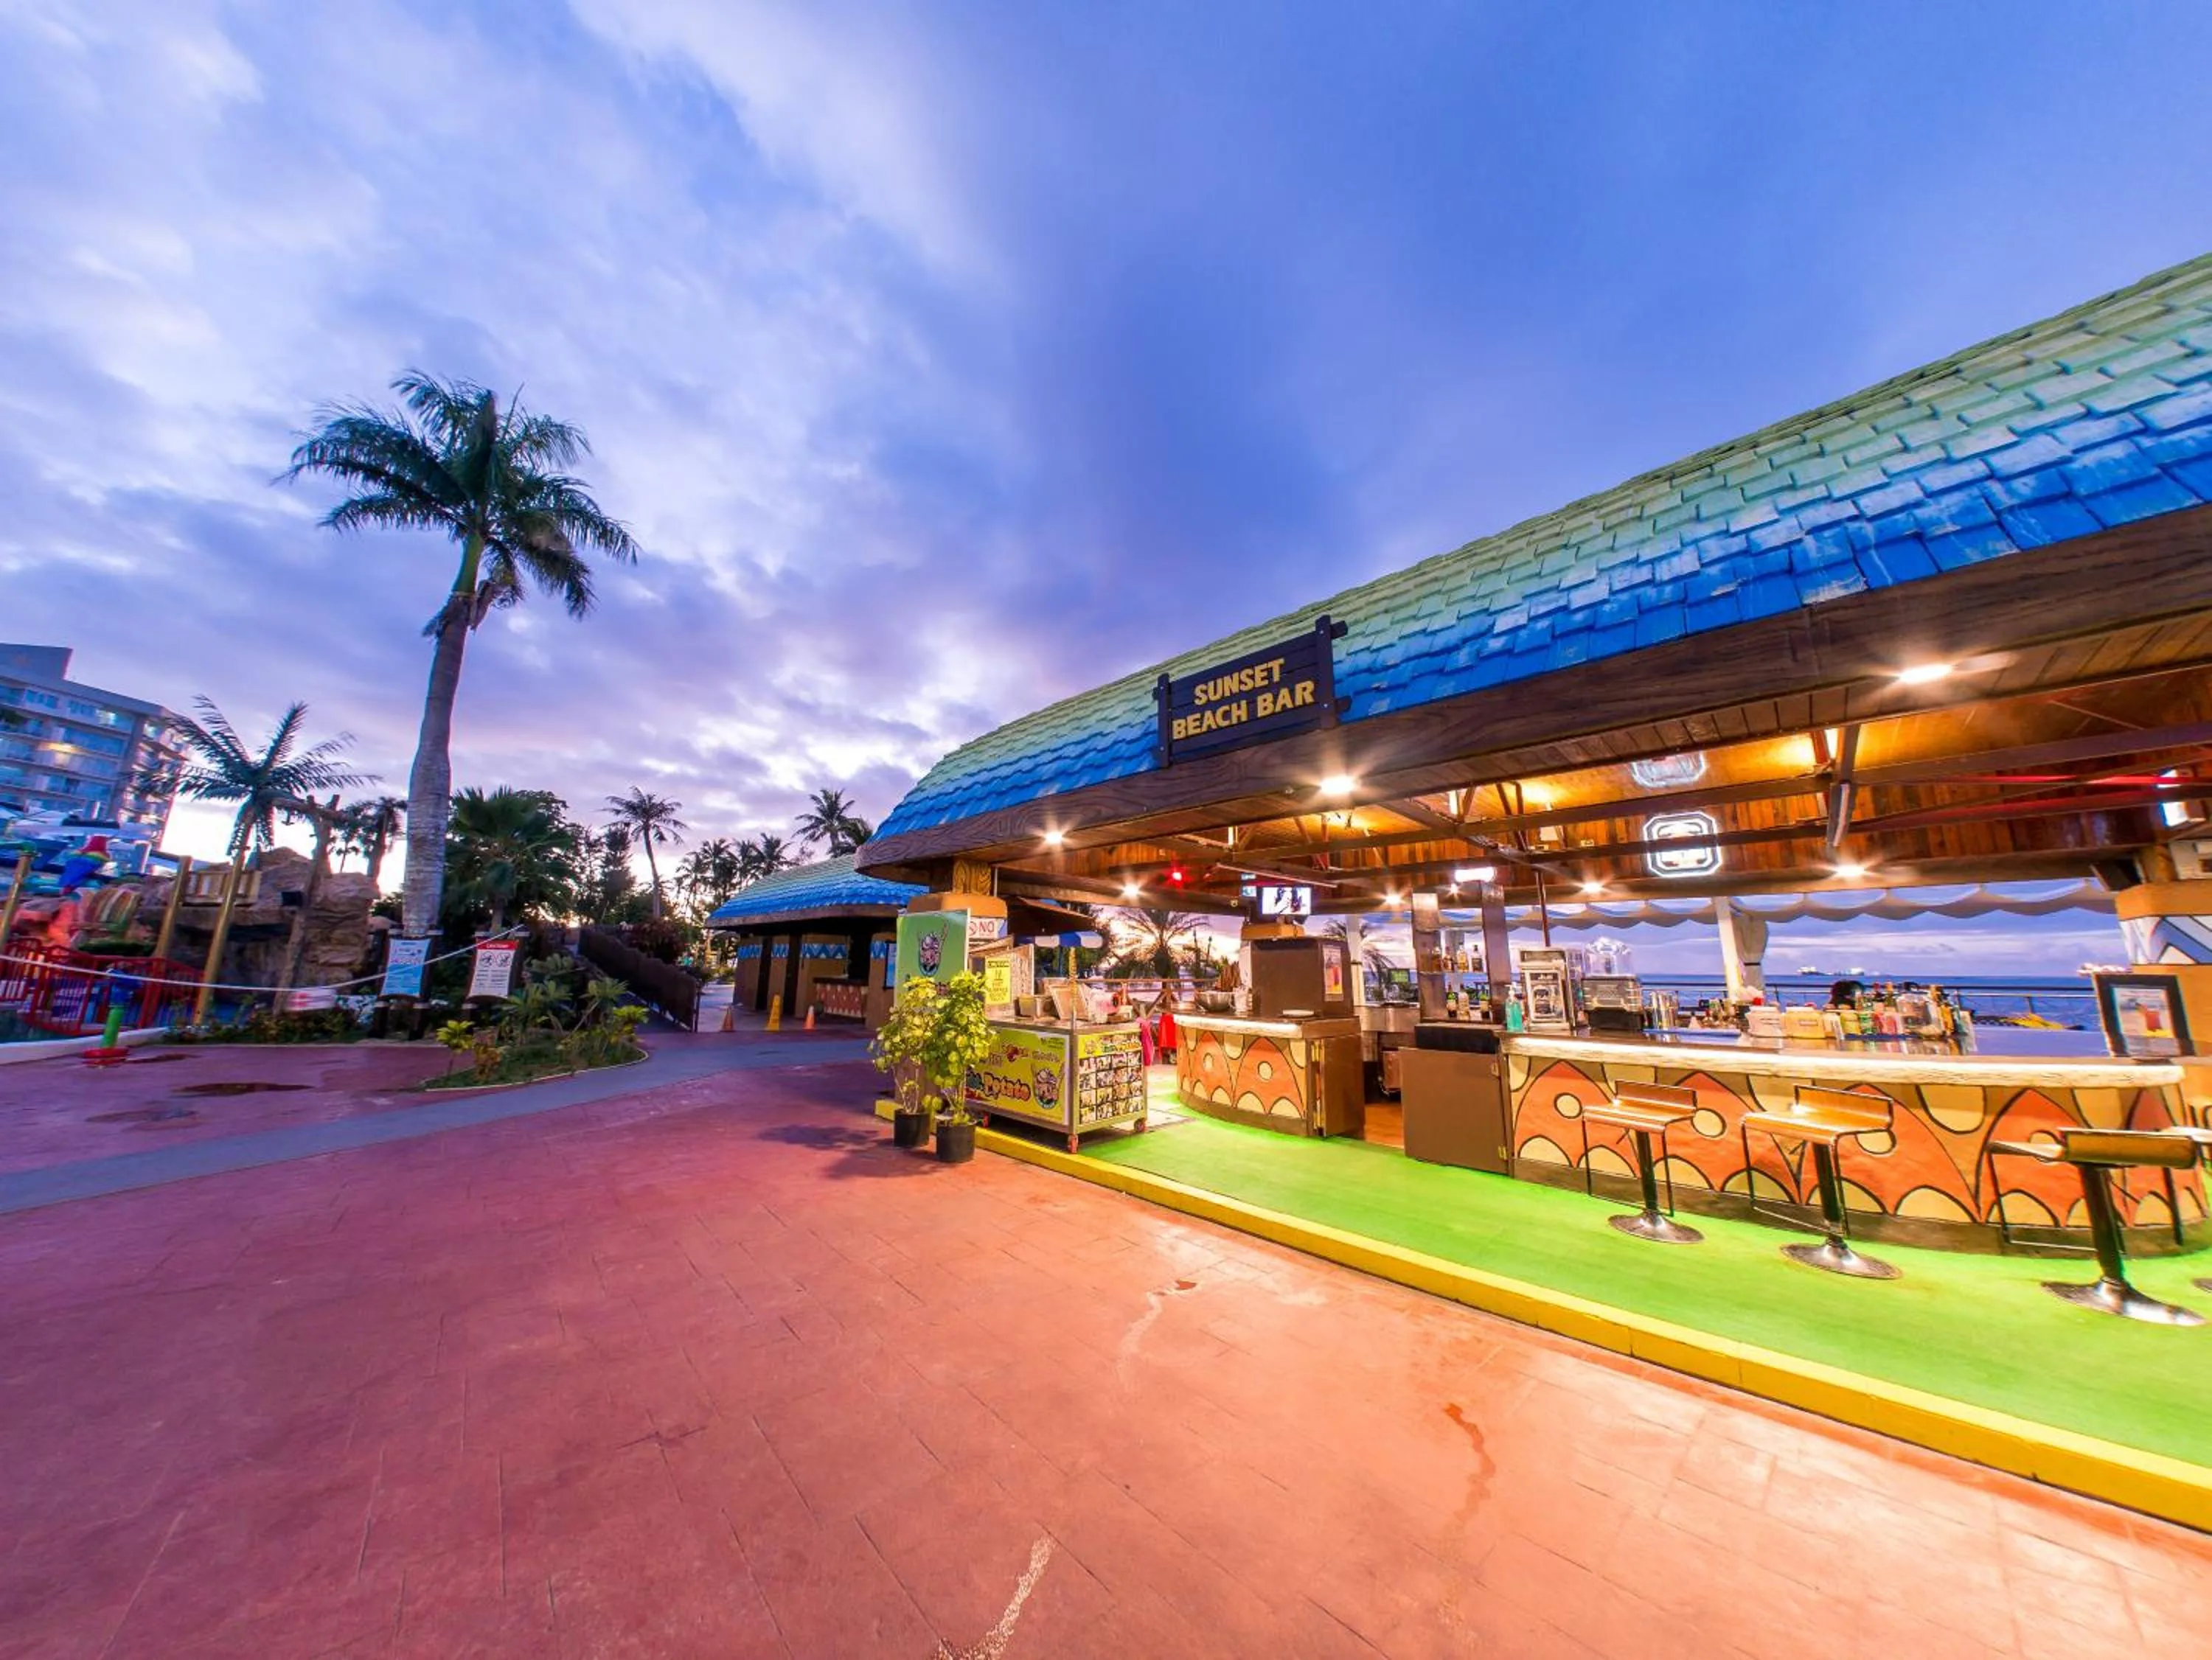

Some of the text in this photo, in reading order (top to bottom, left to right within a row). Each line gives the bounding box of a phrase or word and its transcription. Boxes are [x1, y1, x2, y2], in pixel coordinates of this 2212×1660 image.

[1194, 658, 1284, 705] SUNSET
[1172, 680, 1315, 740] BEACH BAR
[979, 921, 995, 933] NO
